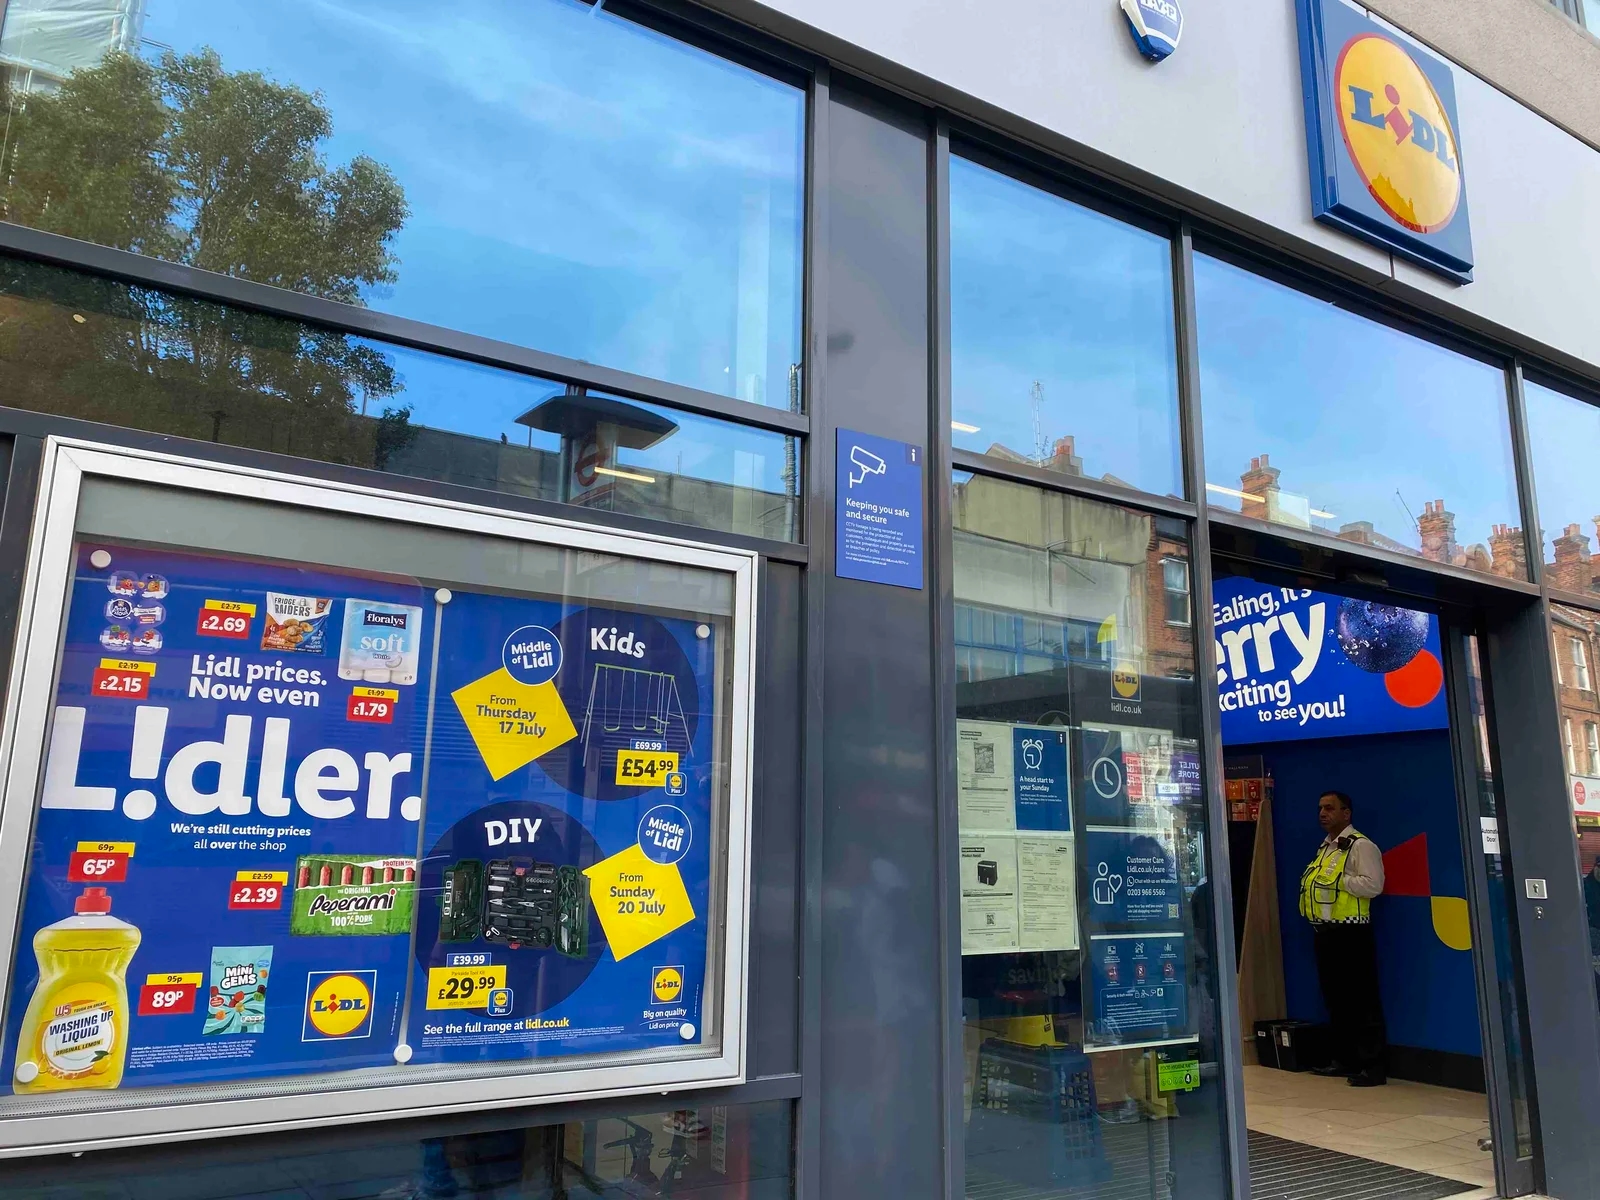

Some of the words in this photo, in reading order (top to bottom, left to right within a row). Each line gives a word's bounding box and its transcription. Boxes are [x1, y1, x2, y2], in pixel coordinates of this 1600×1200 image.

[846, 498, 878, 513] Keeping
[879, 506, 893, 514] you
[894, 508, 910, 518] safe
[846, 510, 861, 520] and
[862, 514, 887, 524] secure
[275, 604, 310, 617] RAIDERS
[1213, 592, 1280, 626] Ealing,
[202, 616, 246, 632] £2.69
[366, 614, 404, 625] floralys
[360, 634, 405, 653] soft
[511, 641, 551, 655] Middle
[590, 628, 646, 658] Kids
[512, 656, 521, 664] of
[523, 652, 553, 669] Lidl
[192, 654, 240, 678] Lidl
[246, 660, 327, 686] prices.
[100, 676, 142, 692] £2.15
[188, 676, 252, 701] Now
[258, 686, 320, 707] even
[490, 695, 516, 705] From
[353, 702, 387, 717] £1.79
[476, 705, 536, 720] Thursday
[1111, 702, 1142, 714] lidl.co.uk
[1258, 710, 1272, 722] to
[1274, 708, 1297, 720] see
[1298, 694, 1346, 726] you!
[500, 721, 512, 734] 17
[516, 722, 546, 738] July
[635, 742, 661, 750] £69.99
[622, 759, 674, 777] £54.99
[171, 823, 205, 834] We're
[208, 824, 230, 834] still
[232, 825, 275, 837] cutting
[277, 826, 311, 837] prices
[485, 818, 542, 846] DIY
[648, 817, 684, 836] Middle
[194, 839, 207, 849] all
[239, 840, 256, 850] the
[259, 840, 286, 852] shop
[654, 830, 682, 851] Lidl
[619, 873, 643, 883] From
[234, 888, 277, 903] £2.39
[609, 886, 655, 900] Sunday
[308, 888, 396, 916] Peperami
[618, 902, 635, 913] 20
[638, 901, 666, 916] July
[330, 915, 354, 926] 100%
[453, 955, 485, 965] £39.99
[167, 976, 182, 984] 95p
[221, 974, 257, 988] GEMS
[438, 976, 496, 1000] £29.99
[55, 1004, 71, 1016] W5
[643, 1010, 654, 1019] Big
[665, 1008, 687, 1018] quality
[50, 1015, 98, 1036] WASHING
[101, 1010, 113, 1022] UP
[424, 1024, 443, 1034] See
[446, 1024, 462, 1034] the
[464, 1022, 481, 1033] full
[484, 1022, 512, 1033] range
[514, 1021, 523, 1030] at
[526, 1017, 569, 1030] lidl.co.uk
[666, 1021, 679, 1029] price
[62, 1025, 99, 1044] LIQUID
[56, 1046, 80, 1056] ORIGINAL
[82, 1040, 100, 1050] LEMON
